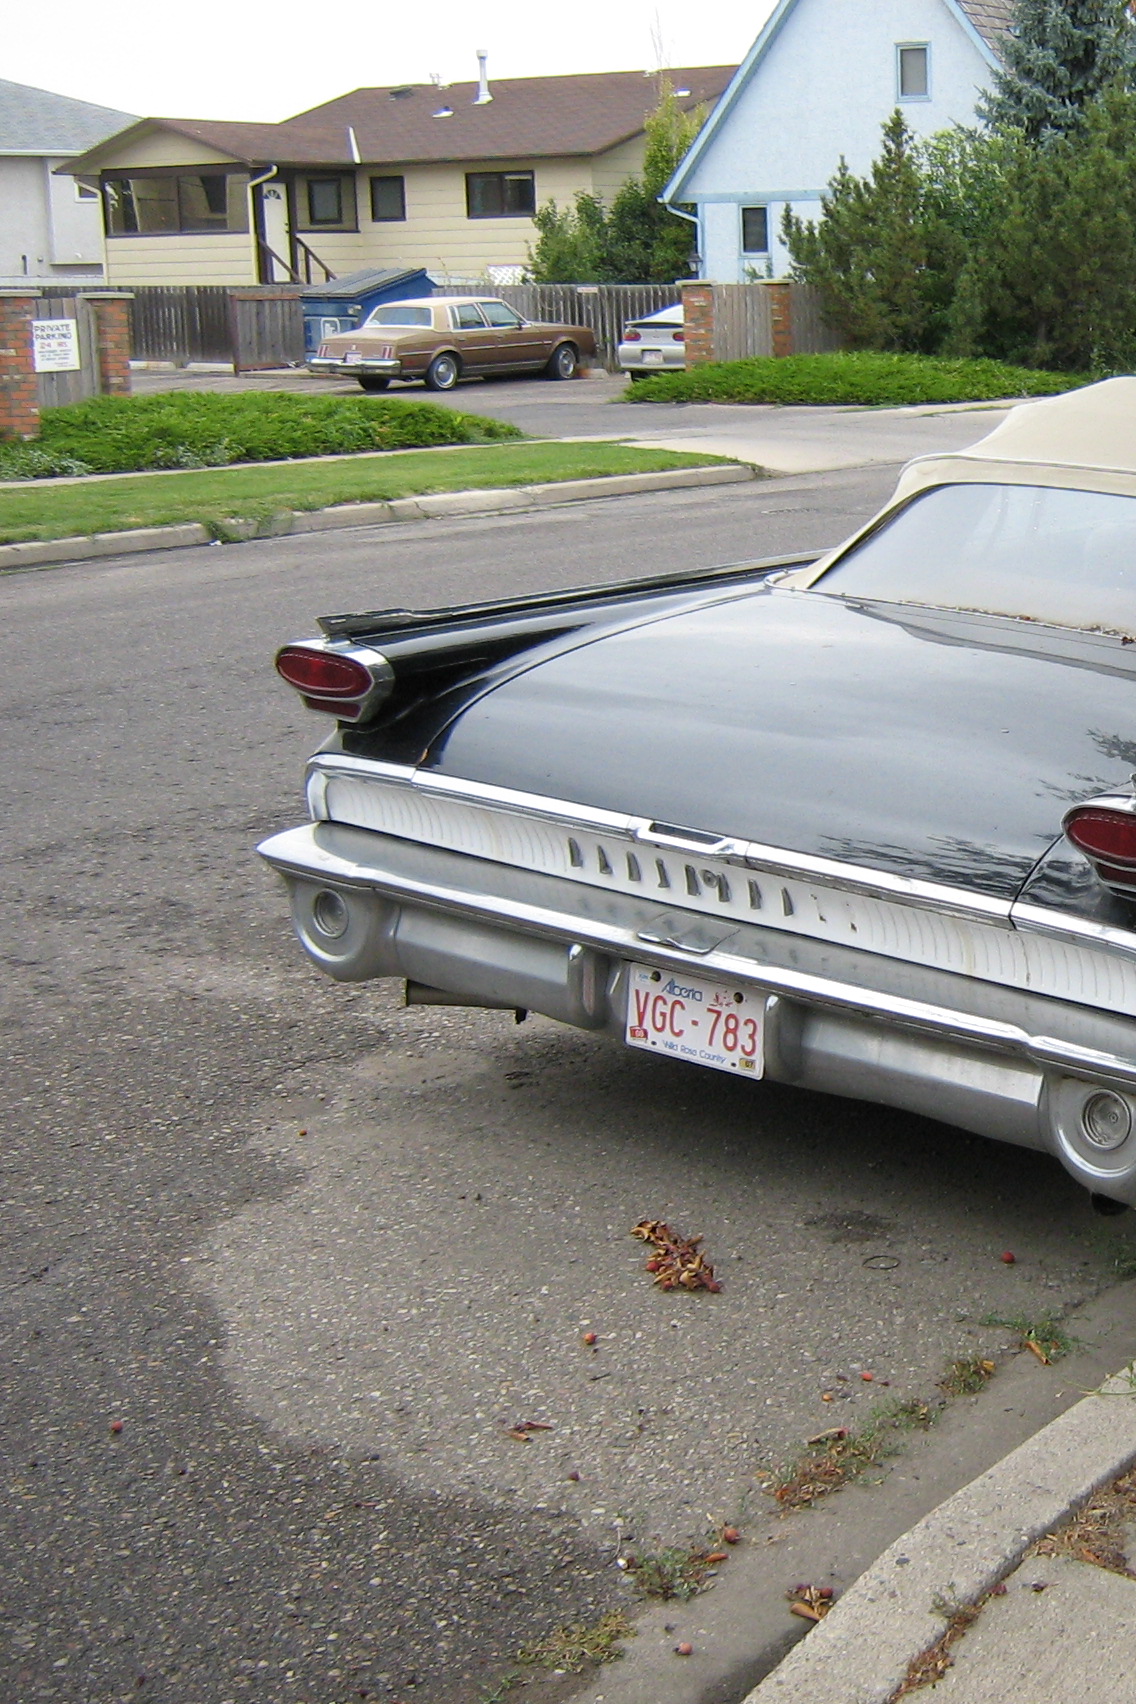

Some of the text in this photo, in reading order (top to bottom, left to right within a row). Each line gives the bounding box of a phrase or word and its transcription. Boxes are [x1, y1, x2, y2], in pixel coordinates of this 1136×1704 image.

[34, 324, 71, 332] PRIVATE
[35, 332, 72, 340] PARKING
[661, 978, 703, 1002] Alberta
[635, 989, 757, 1057] VGC-783
[662, 1039, 727, 1064] Wild Rose Country
